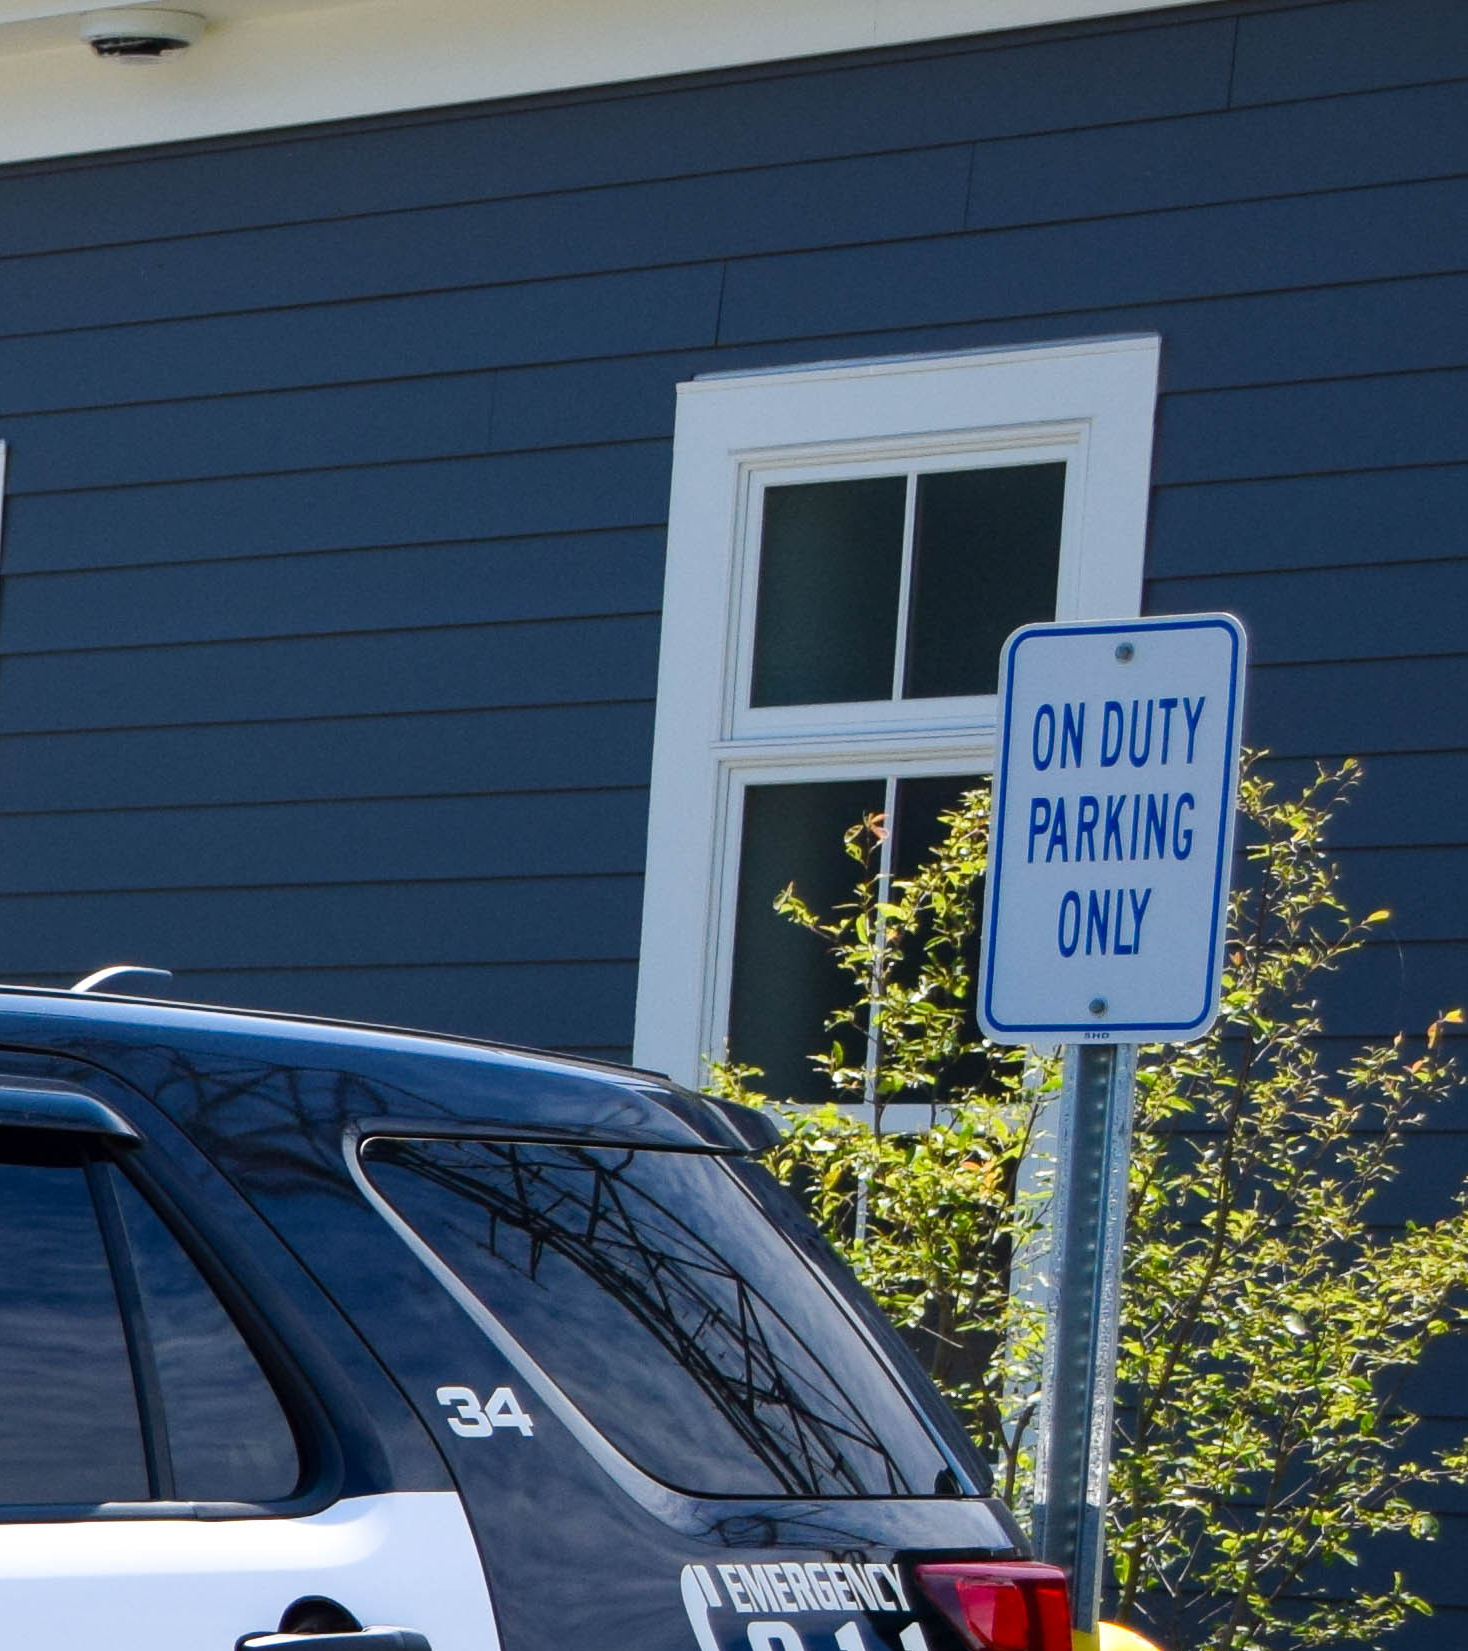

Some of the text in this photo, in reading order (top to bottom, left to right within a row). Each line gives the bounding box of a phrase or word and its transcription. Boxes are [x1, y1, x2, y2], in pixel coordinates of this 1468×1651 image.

[1032, 696, 1206, 771] ON DUTY
[1027, 792, 1195, 864] PARKING
[1057, 888, 1152, 958] ONLY
[436, 1386, 534, 1439] 34
[716, 1562, 911, 1614] EMERGENCY
